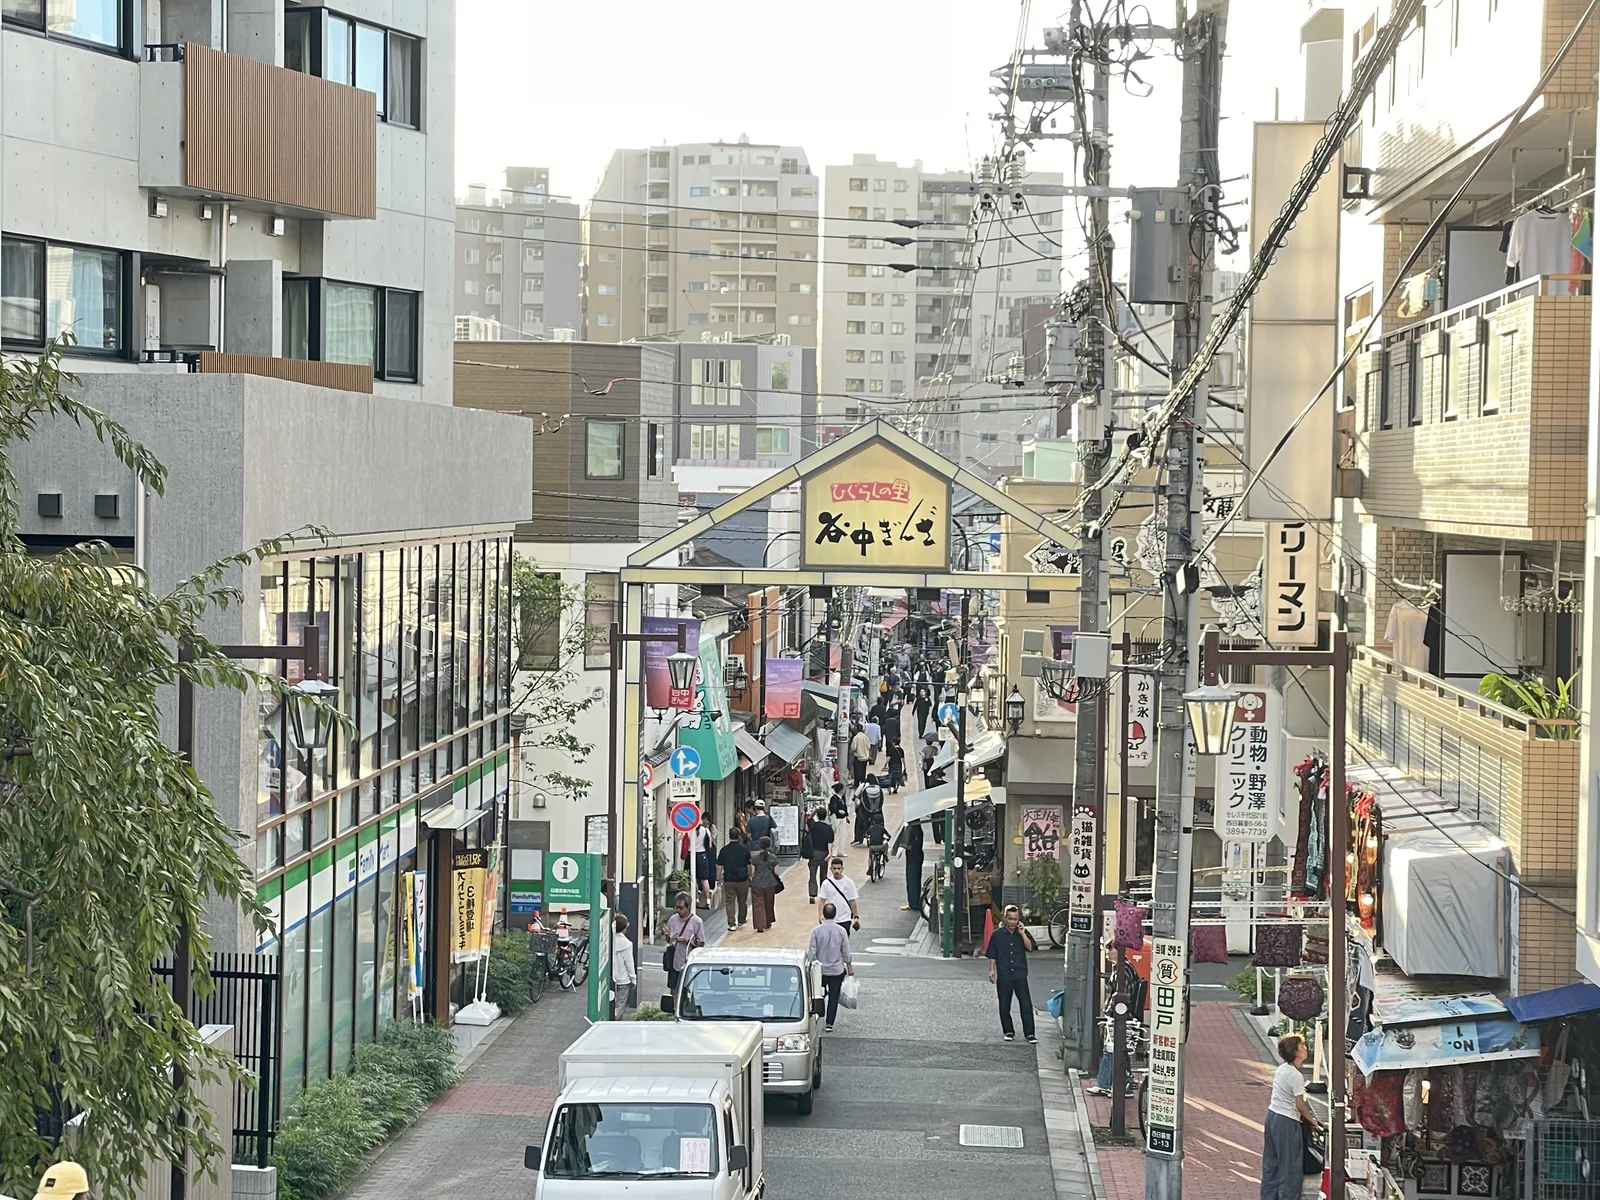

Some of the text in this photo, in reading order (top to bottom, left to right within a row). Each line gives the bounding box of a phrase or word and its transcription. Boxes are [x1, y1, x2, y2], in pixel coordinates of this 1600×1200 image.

[832, 478, 909, 503] ひぐらしの里
[815, 499, 937, 556] 谷中ぎんざ
[1137, 681, 1149, 718] かき氷
[1229, 725, 1247, 809] クリニック
[1248, 725, 1268, 810] 動物・野澤
[1073, 828, 1081, 855] のお店
[1081, 821, 1093, 860] 猫雑貨
[1225, 827, 1268, 836] 3894-7739
[1161, 963, 1174, 980] 質
[1156, 986, 1175, 1030] 田戸
[1448, 1040, 1475, 1052] No.
[1152, 1139, 1170, 1148] 3-13
